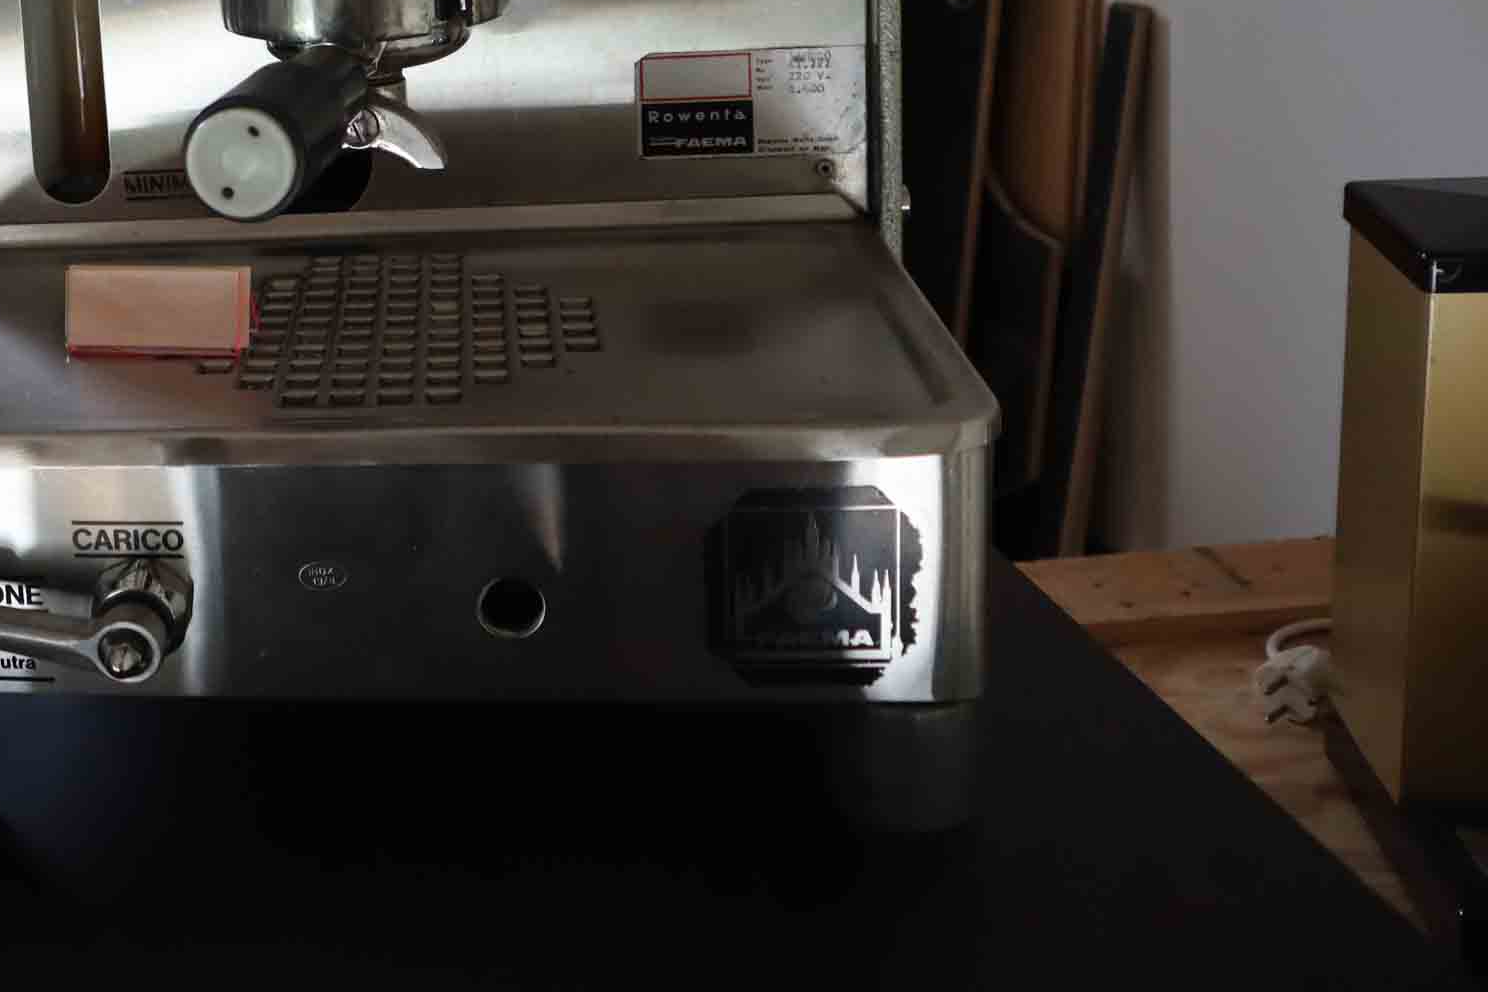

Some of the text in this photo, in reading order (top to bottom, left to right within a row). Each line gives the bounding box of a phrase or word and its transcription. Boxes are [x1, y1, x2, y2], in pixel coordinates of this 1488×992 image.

[648, 108, 747, 124] Rowenta
[649, 136, 747, 147] FAEMA
[123, 175, 194, 193] MINIM
[71, 528, 185, 552] CARICO
